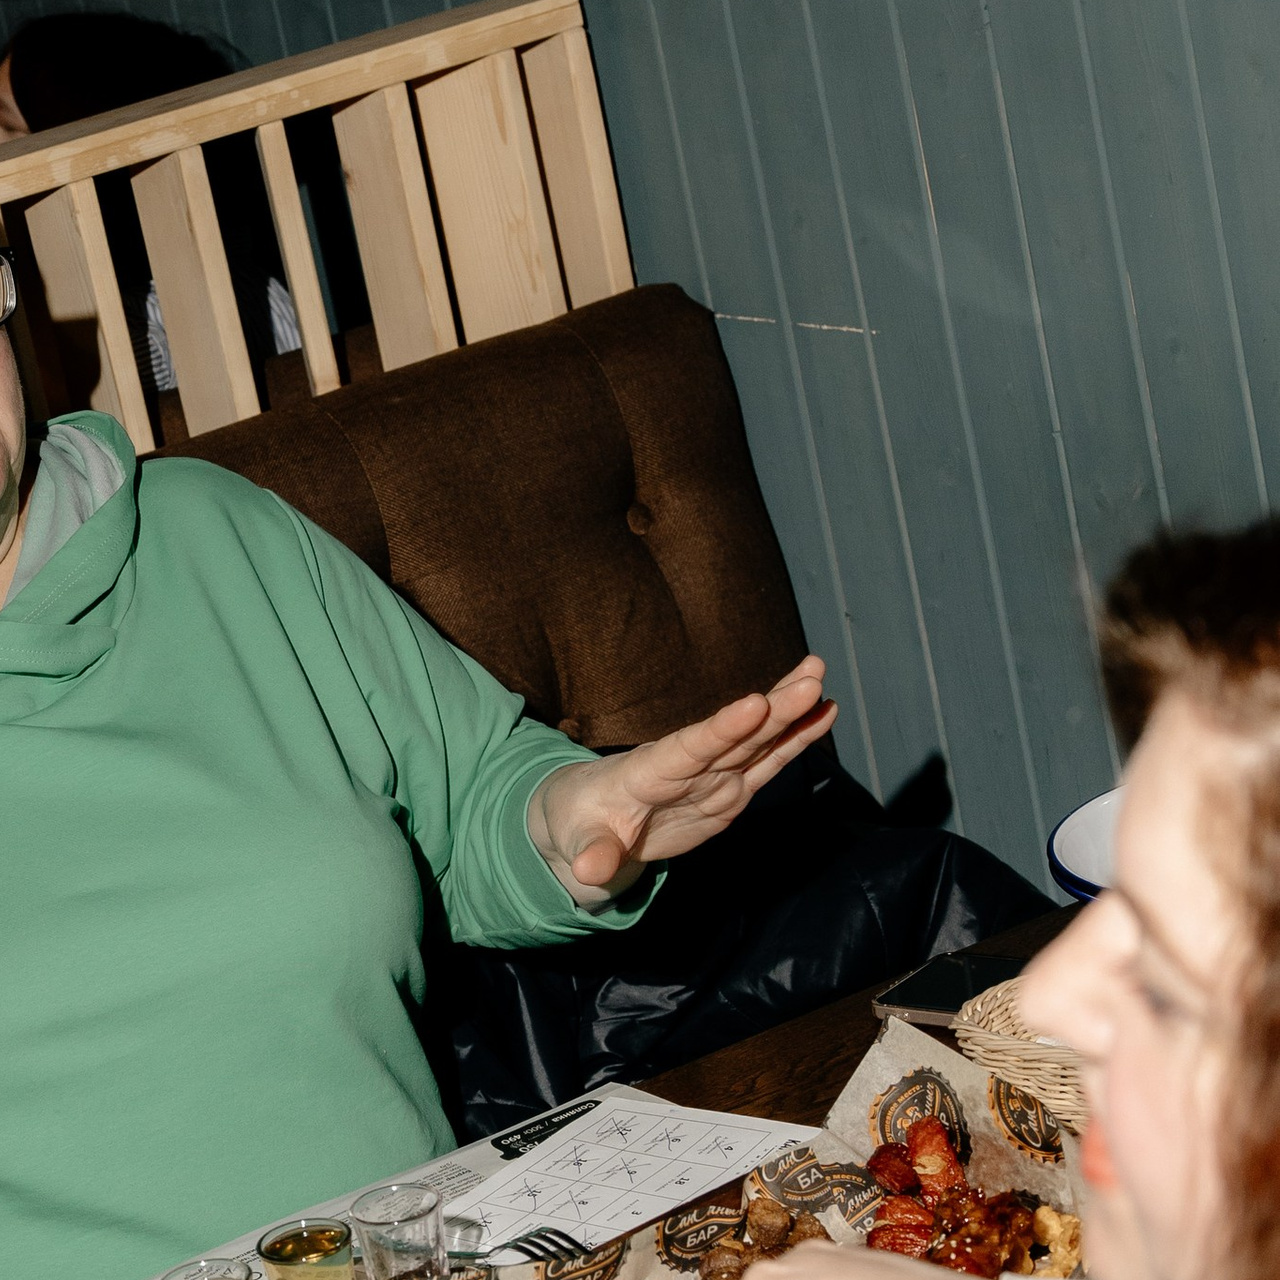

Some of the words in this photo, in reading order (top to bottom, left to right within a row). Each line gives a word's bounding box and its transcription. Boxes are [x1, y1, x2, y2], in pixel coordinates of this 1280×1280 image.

[551, 1102, 596, 1123] Солянка
[501, 1134, 522, 1145] 490
[797, 1167, 823, 1190] БА
[686, 1225, 718, 1248] БАР
